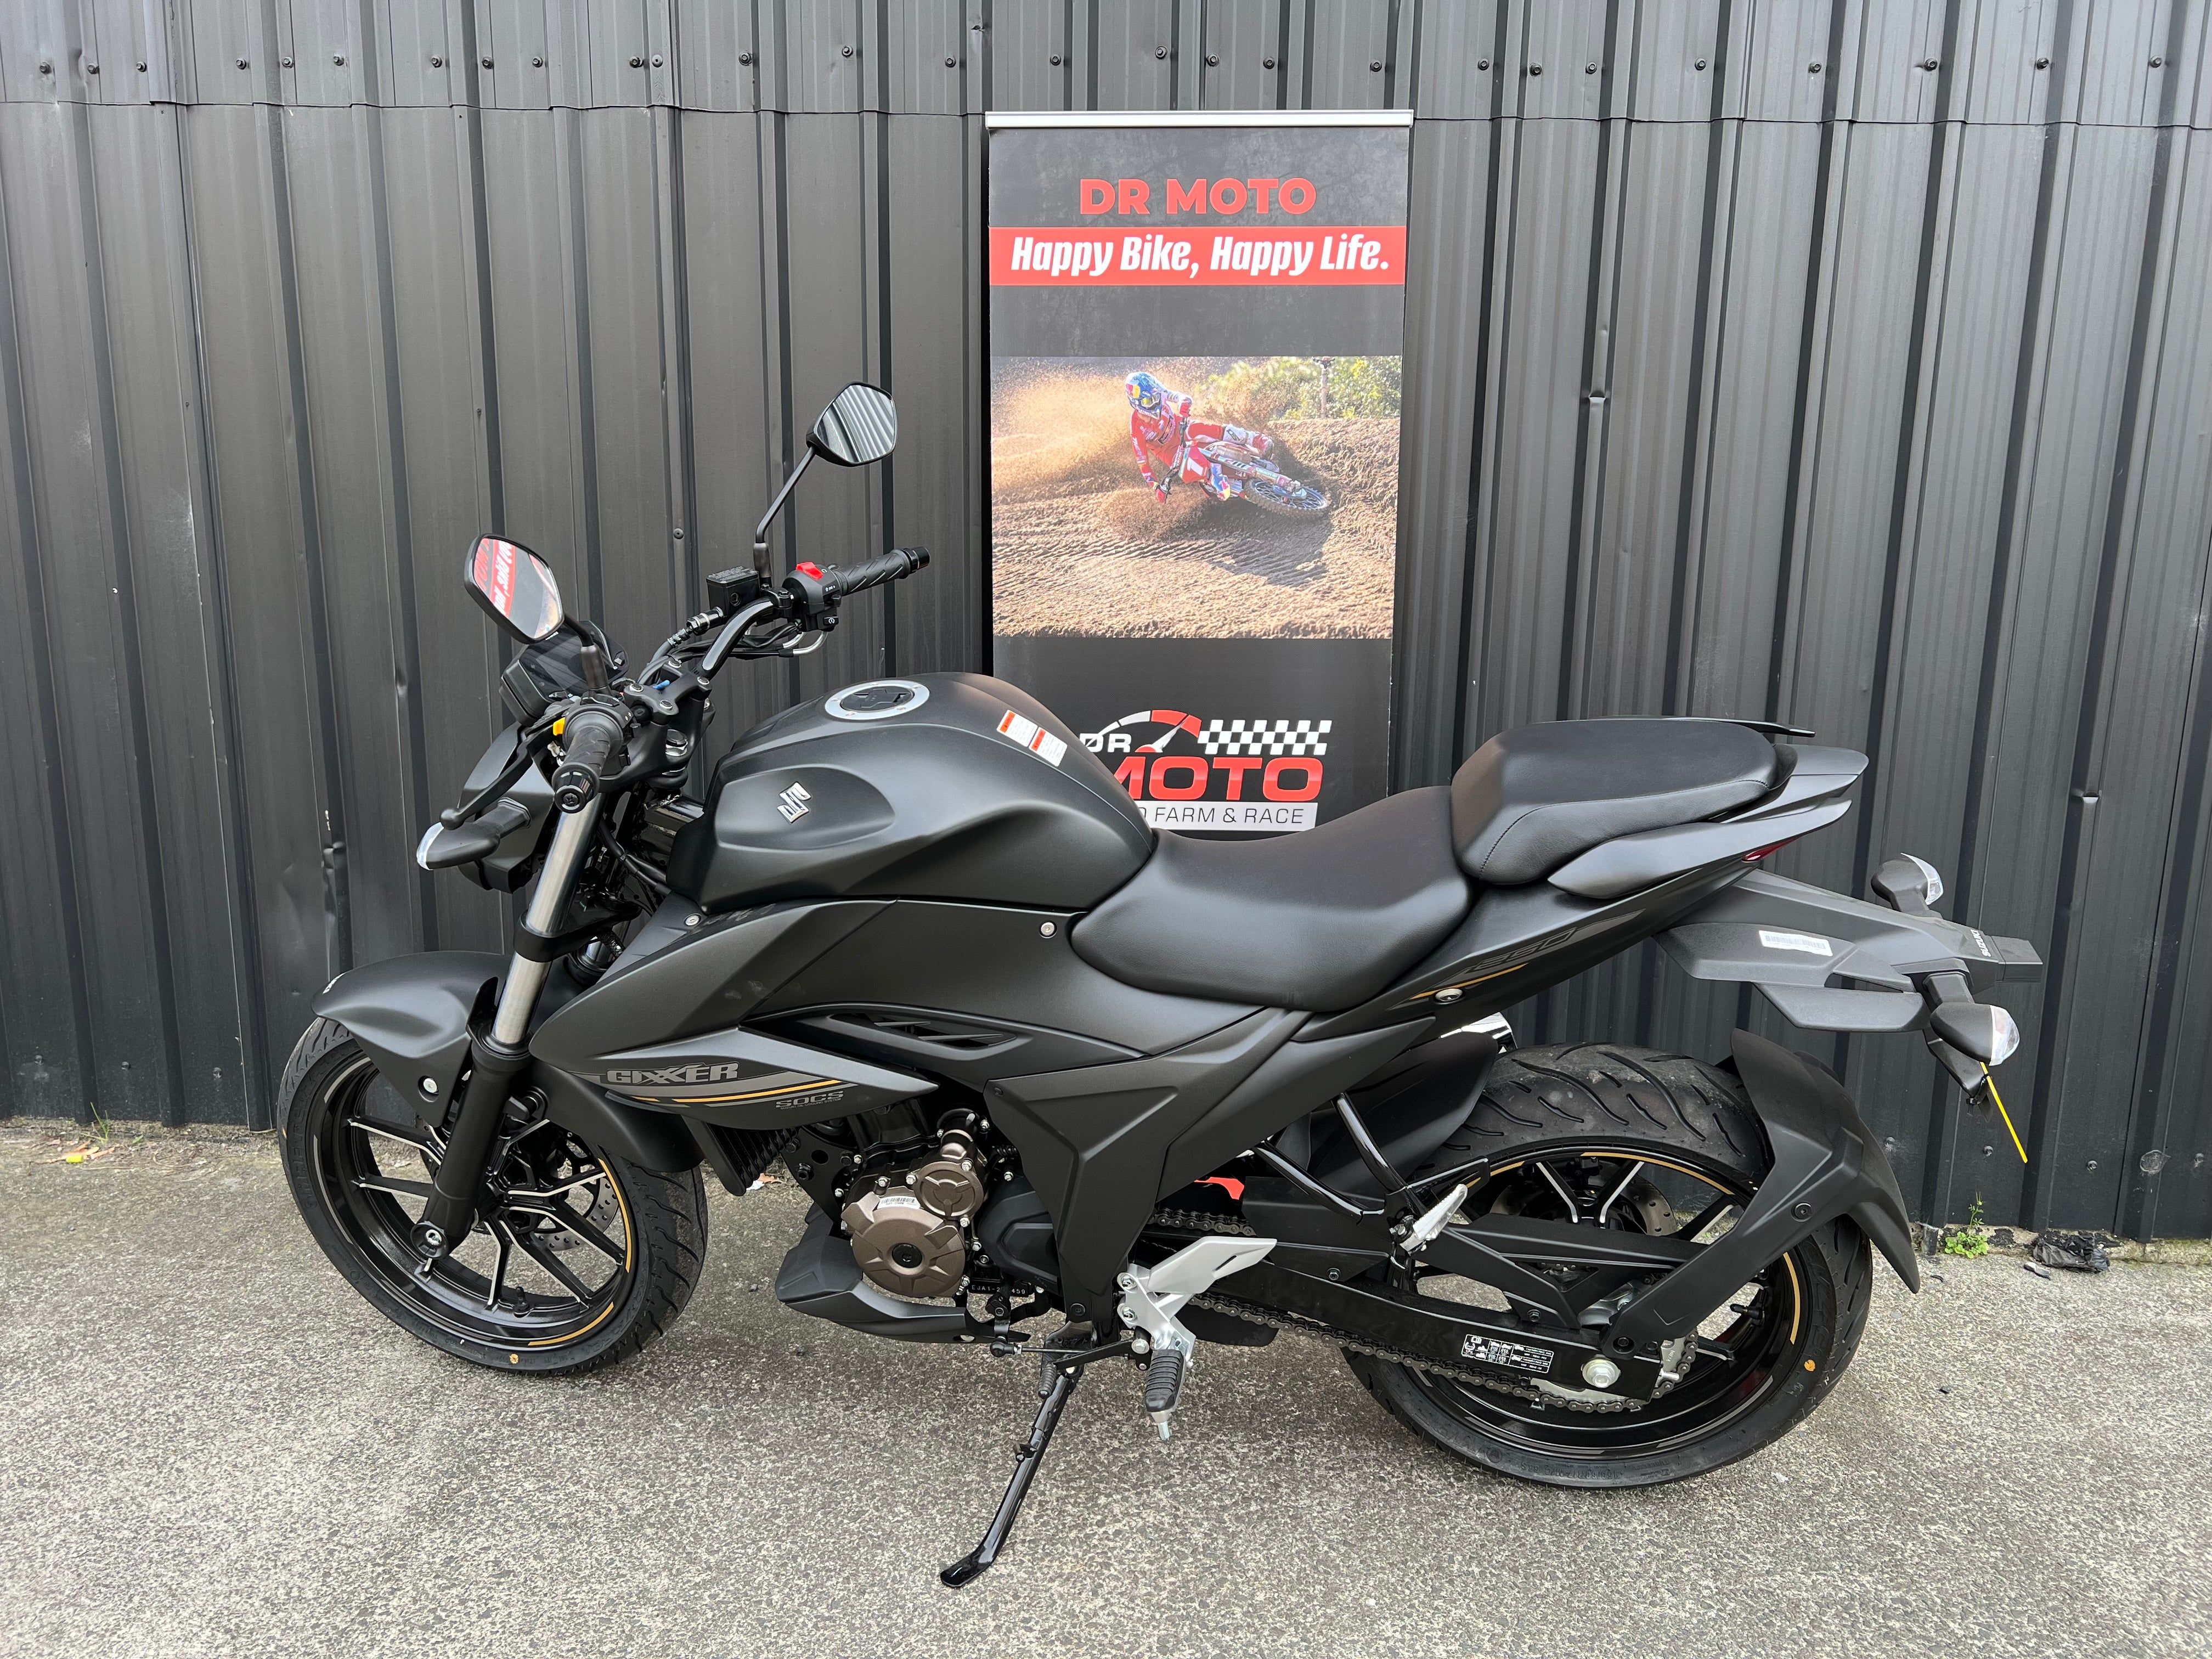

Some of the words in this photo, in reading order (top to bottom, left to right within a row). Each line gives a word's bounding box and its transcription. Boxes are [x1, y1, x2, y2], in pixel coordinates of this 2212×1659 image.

[1080, 178, 1150, 215] DR
[1166, 177, 1317, 215] MOTO
[1011, 236, 1113, 277] Happy
[1120, 234, 1200, 279] Bike,
[1210, 236, 1314, 277] Happy
[1320, 233, 1389, 270] Life.
[1080, 733, 1132, 753] DR
[1155, 807, 1215, 822] FARM
[1222, 808, 1237, 823] &
[1244, 808, 1304, 823] RACE
[1970, 928, 1991, 957] SUZUKI
[607, 1062, 739, 1085] GIXXER
[775, 1091, 844, 1108] SOCS
[972, 1284, 1025, 1294] EJA1-2459
